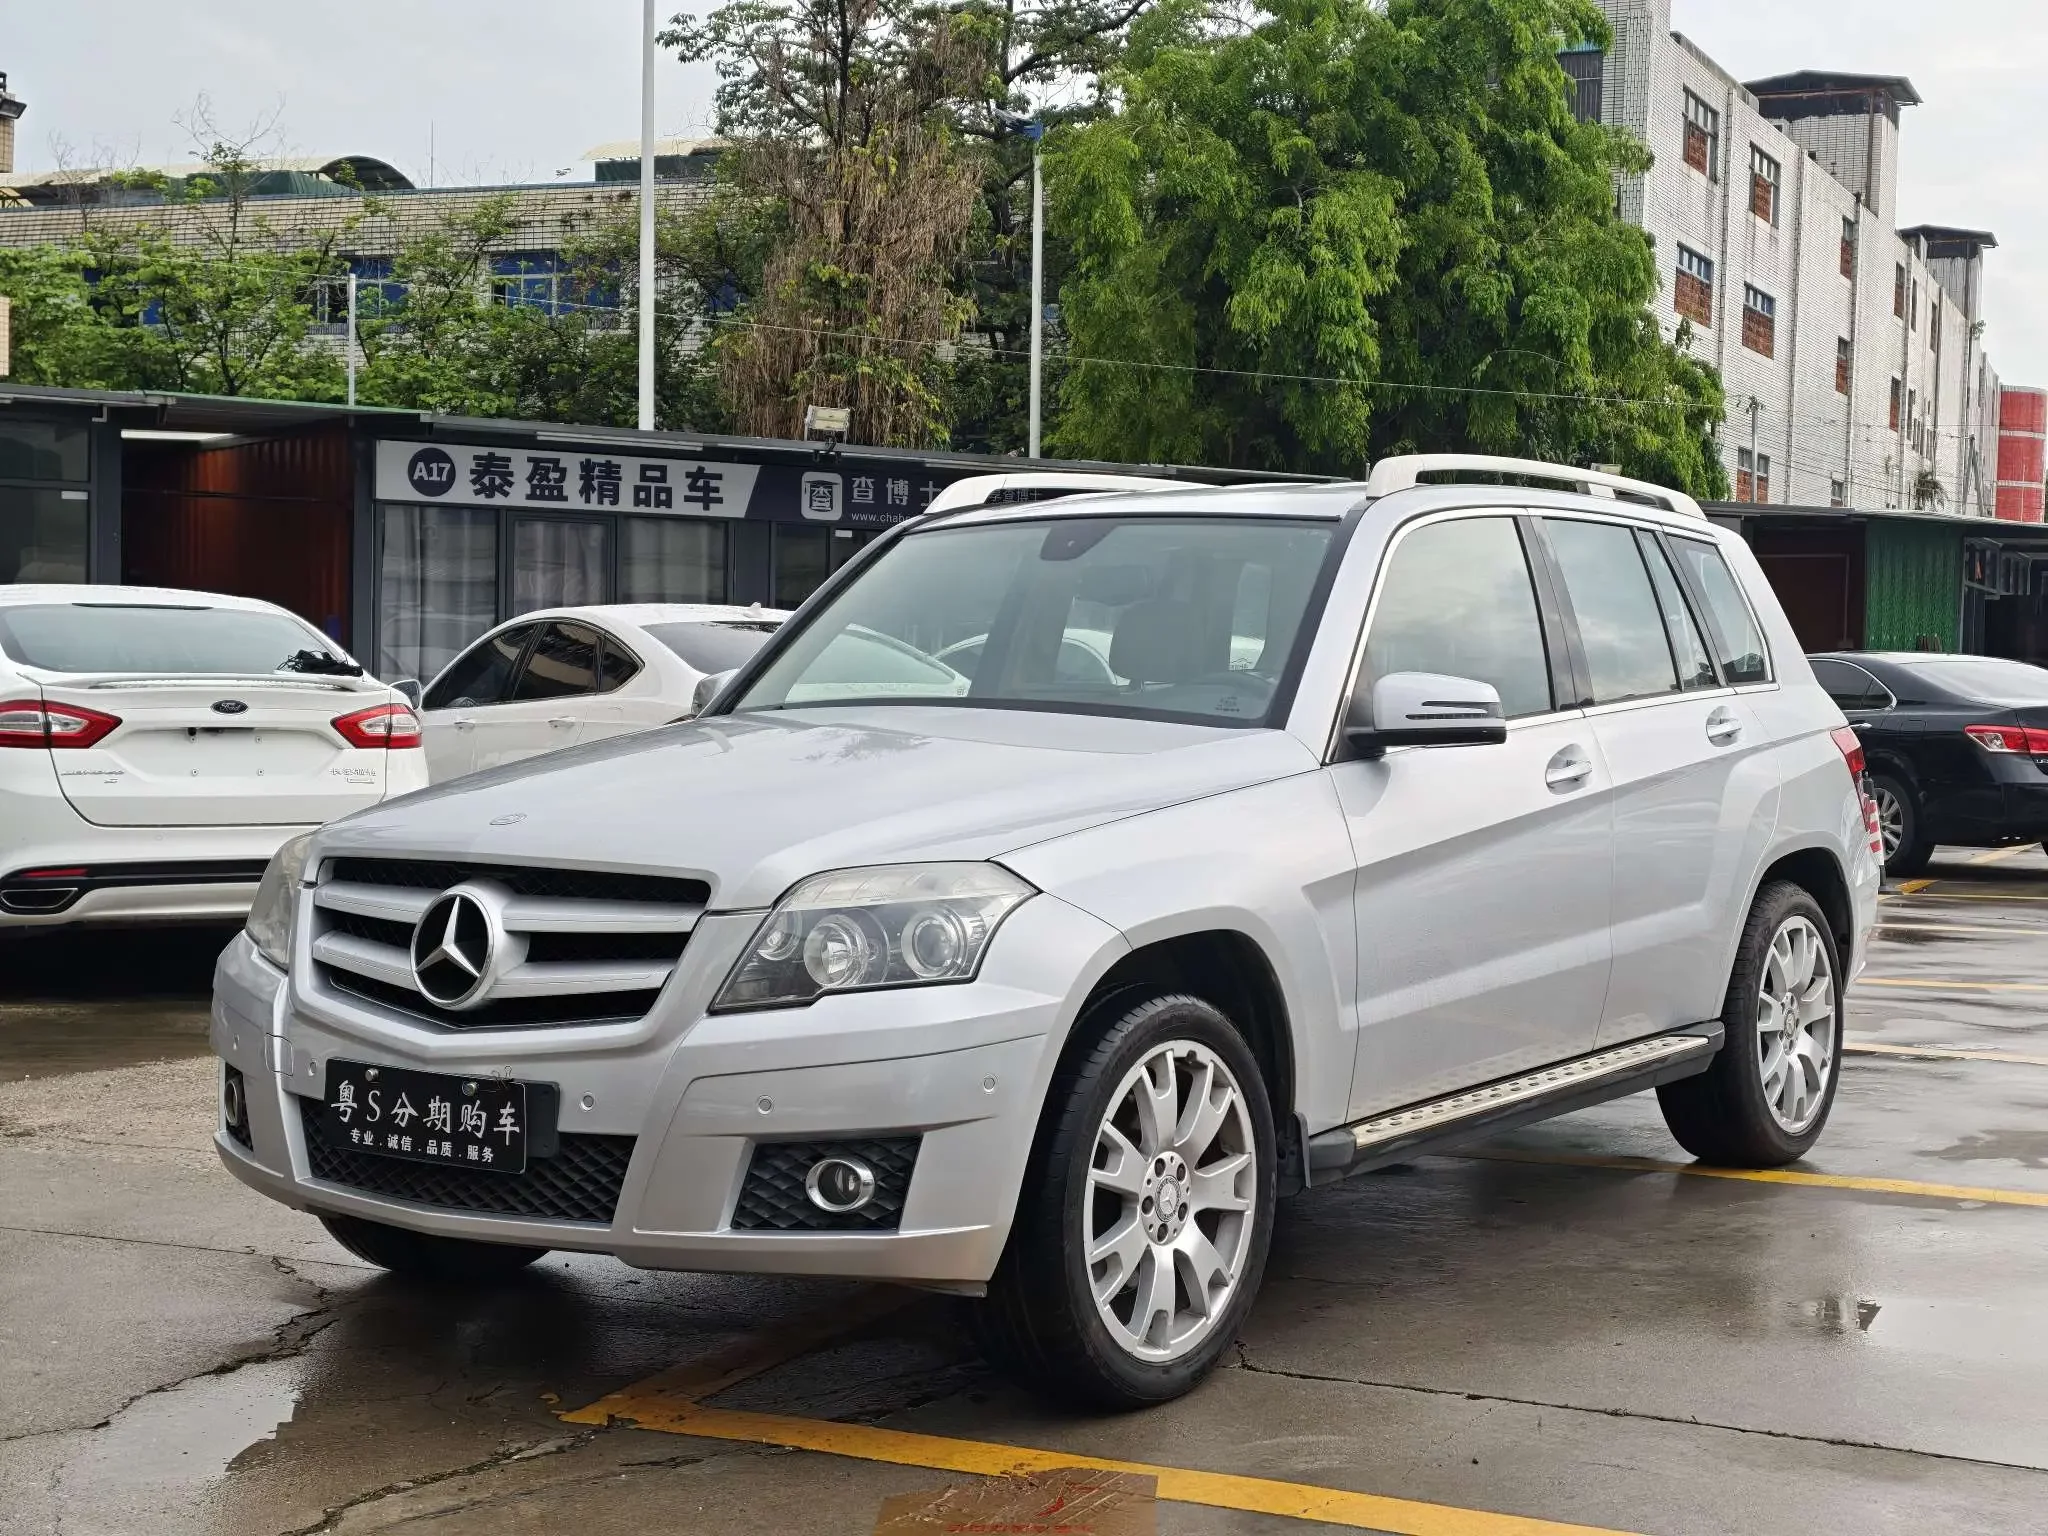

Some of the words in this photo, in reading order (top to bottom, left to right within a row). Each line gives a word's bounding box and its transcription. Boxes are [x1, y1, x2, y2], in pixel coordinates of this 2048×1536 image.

[412, 457, 451, 483] A17
[468, 452, 724, 511] 泰盈精品车
[330, 1080, 520, 1146] 粤S分期购车
